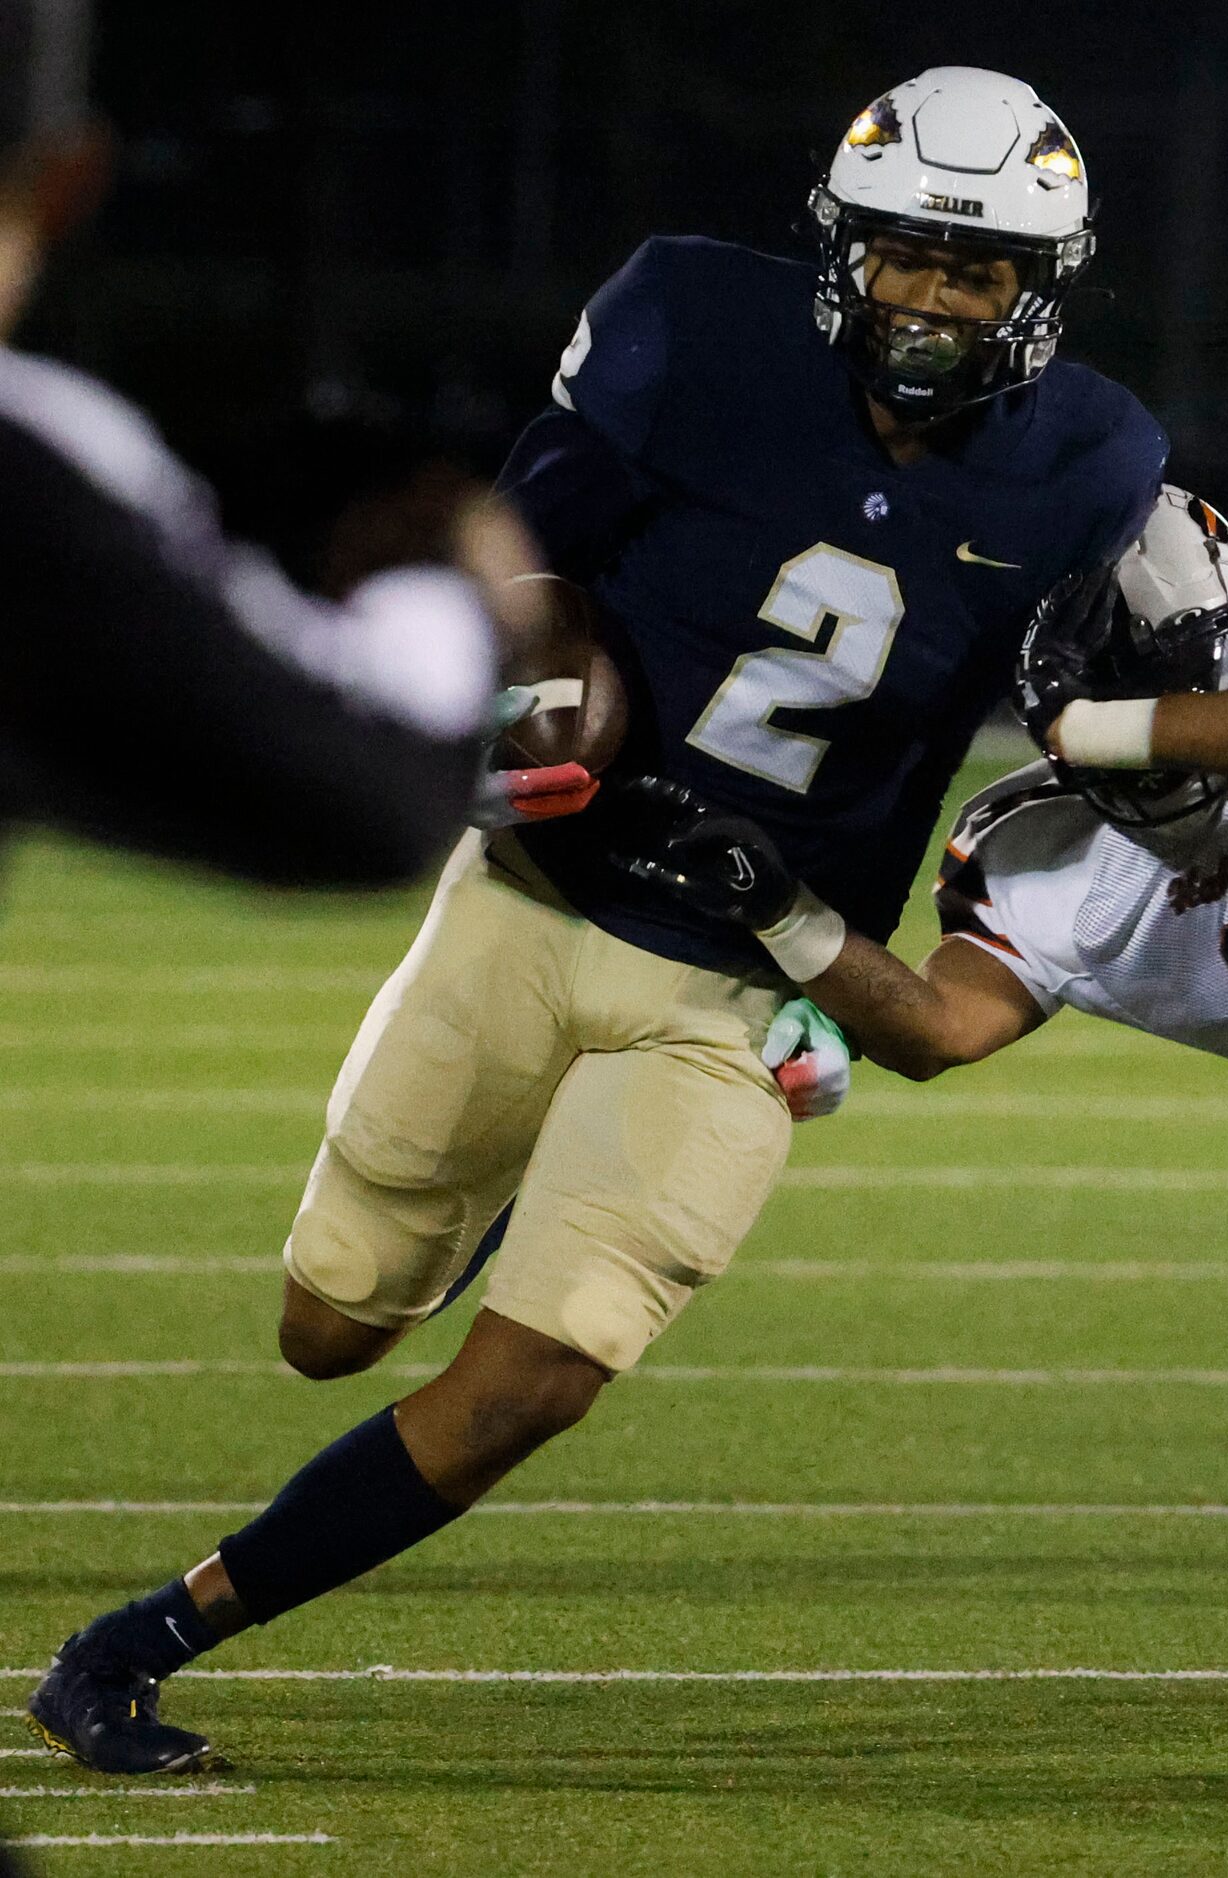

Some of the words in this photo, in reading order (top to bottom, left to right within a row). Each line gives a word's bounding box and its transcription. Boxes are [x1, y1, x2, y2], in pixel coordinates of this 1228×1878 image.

[920, 193, 984, 217] ELLER
[898, 384, 934, 397] Riddell
[685, 541, 905, 794] 2
